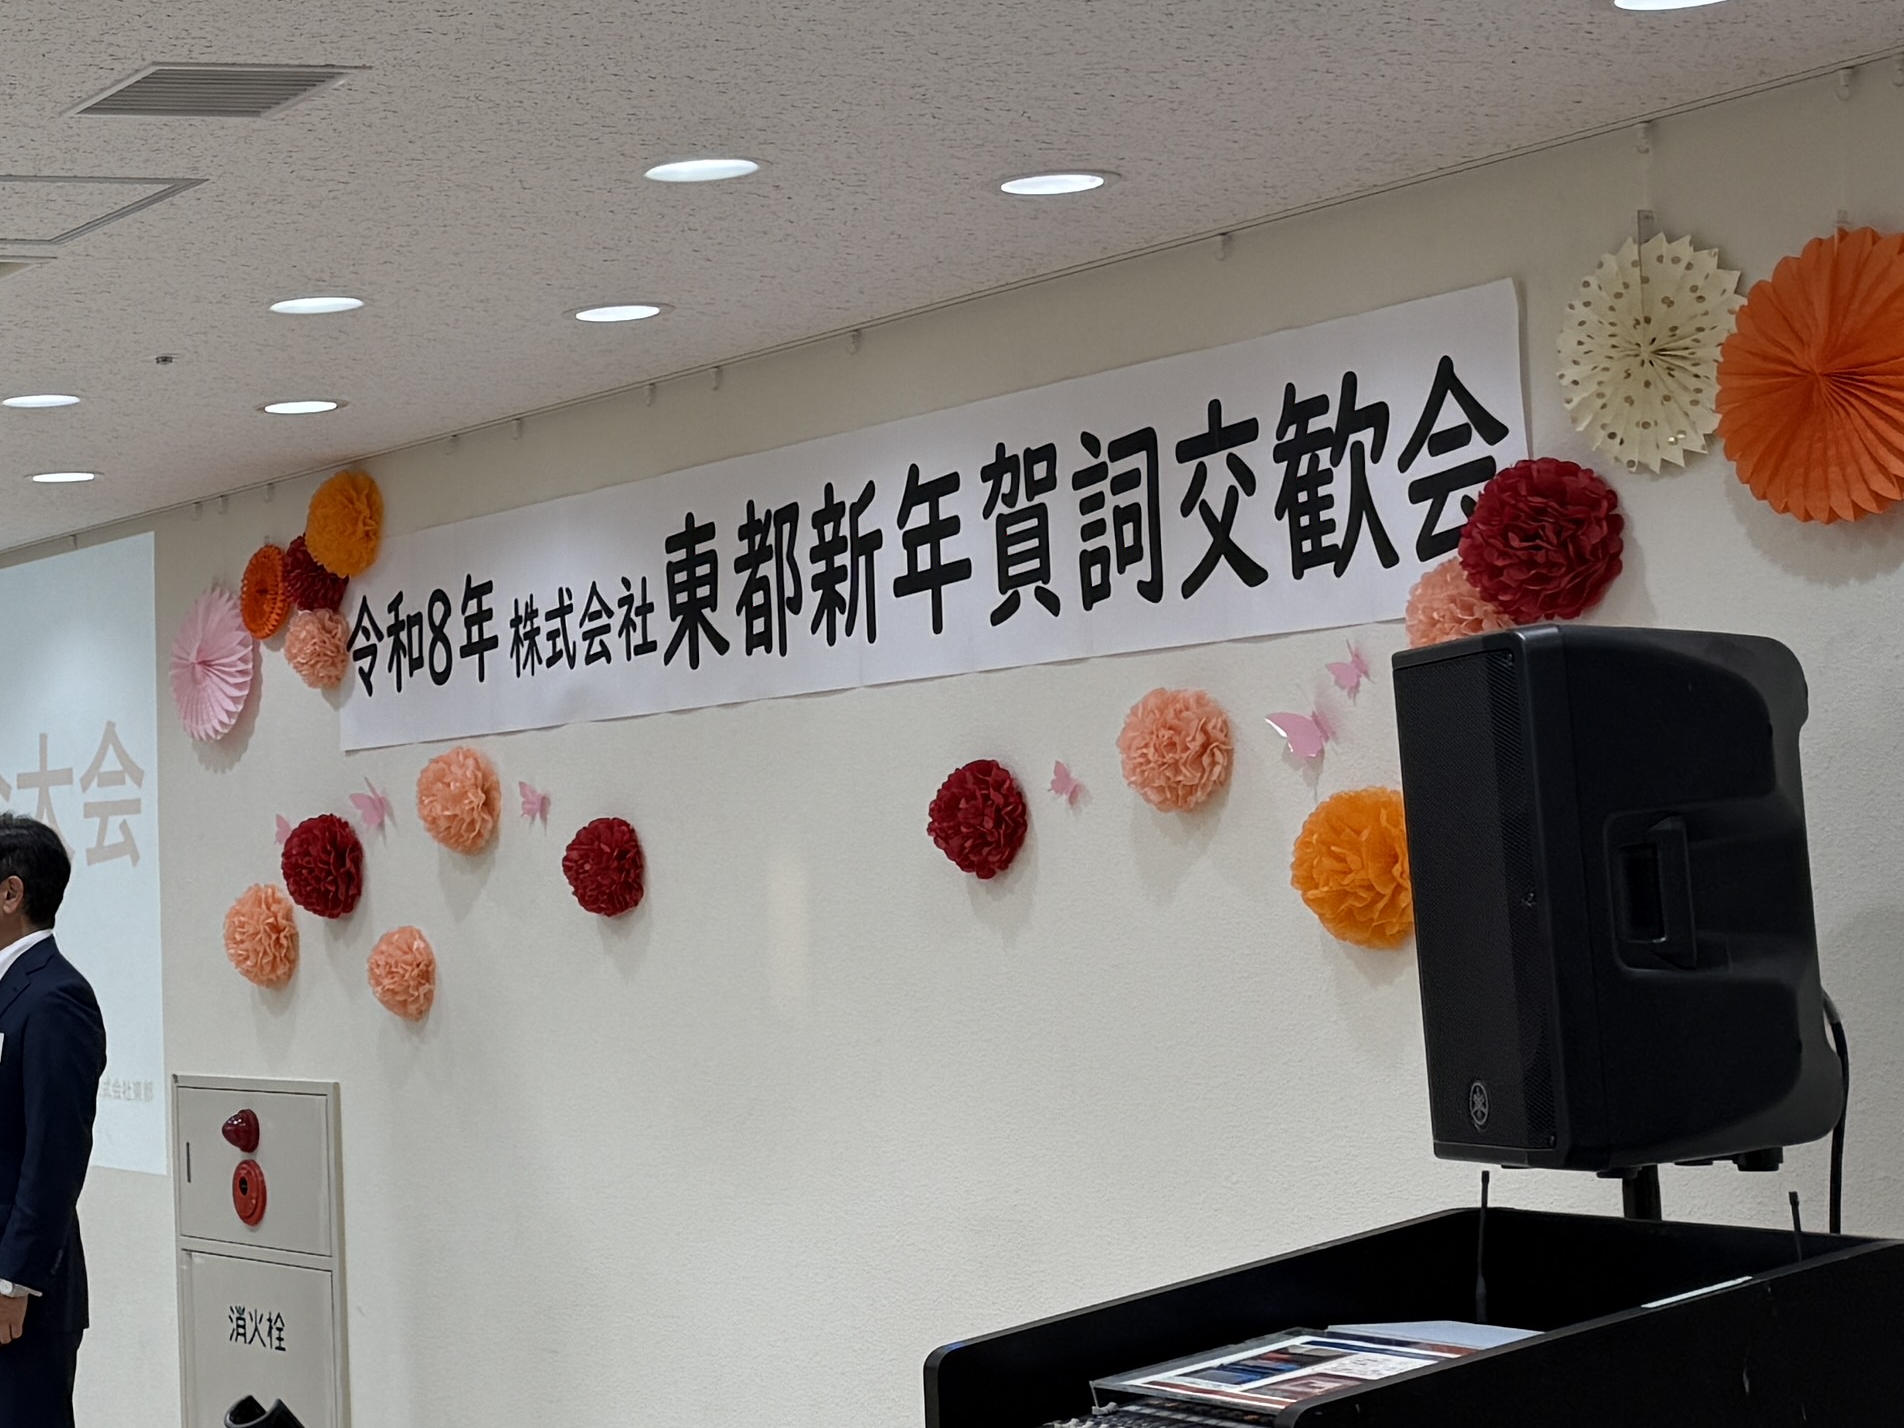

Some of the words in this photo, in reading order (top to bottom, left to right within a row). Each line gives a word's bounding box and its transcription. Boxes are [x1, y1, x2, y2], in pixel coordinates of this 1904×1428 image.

[345, 573, 501, 698] 令和8年
[508, 575, 659, 679] 株式会社
[228, 1305, 287, 1353] 消火栓
